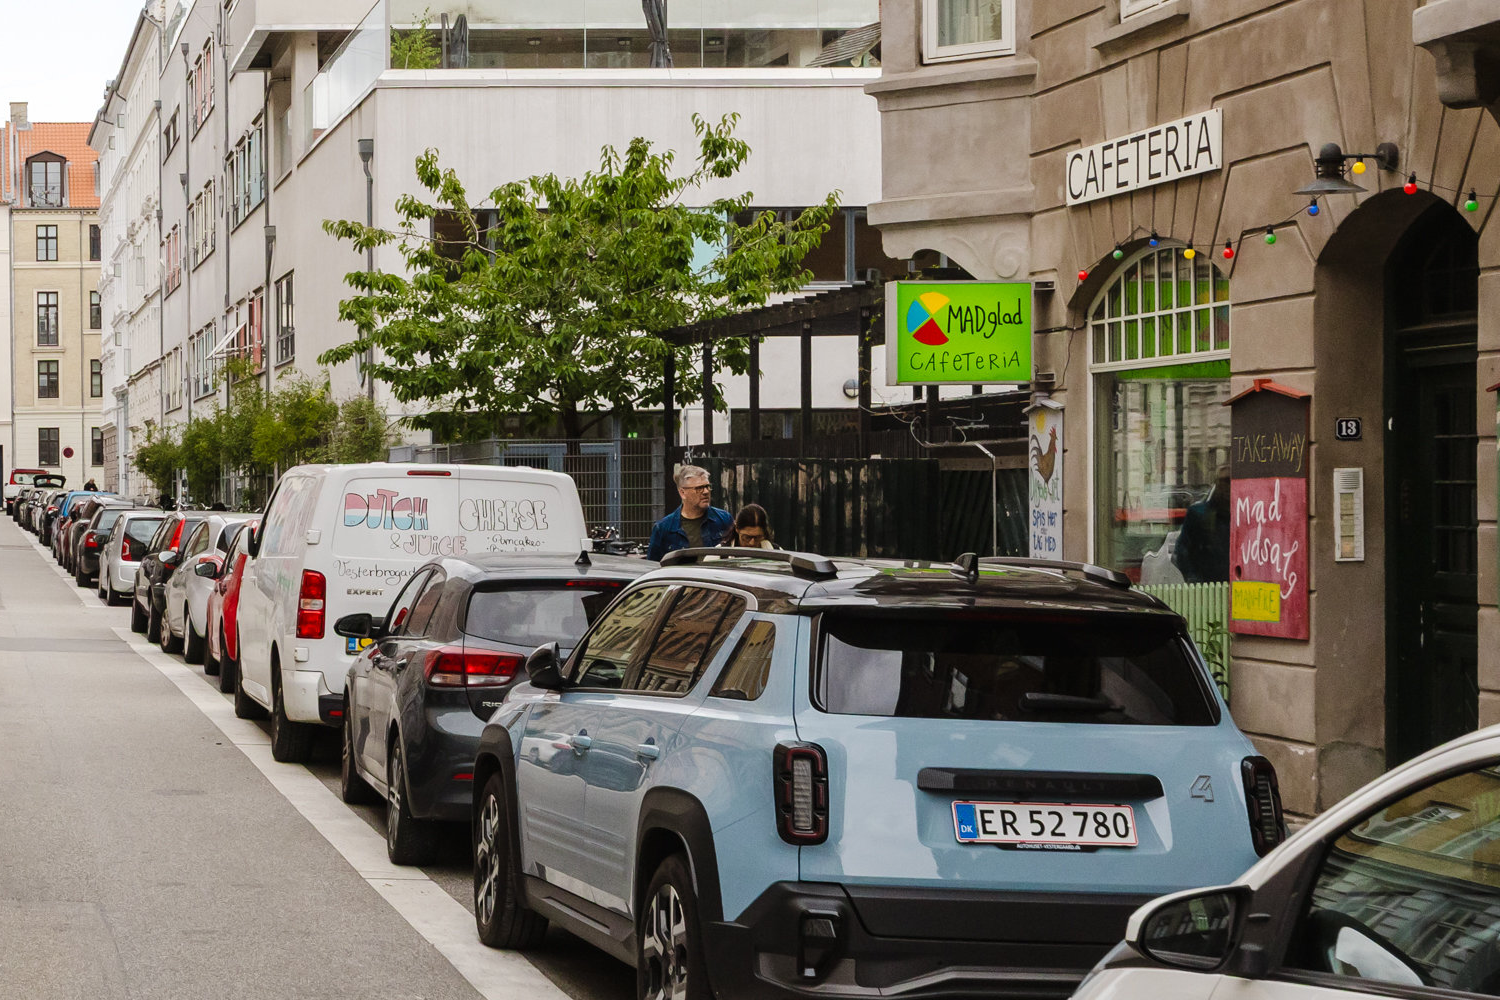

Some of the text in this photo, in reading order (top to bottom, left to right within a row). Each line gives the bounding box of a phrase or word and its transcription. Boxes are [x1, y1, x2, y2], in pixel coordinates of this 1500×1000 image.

[1068, 116, 1213, 200] CAFETERIA
[1340, 420, 1357, 436] 13
[1233, 432, 1306, 472] TAKE-AWAY
[343, 488, 429, 531] DUTCH
[458, 498, 549, 532] CHEESE
[1236, 479, 1282, 527] Mad
[389, 533, 401, 550] &
[346, 588, 385, 597] EXPERT
[987, 778, 1106, 792] RENAULT
[960, 809, 1130, 838] DK ER 52 780
